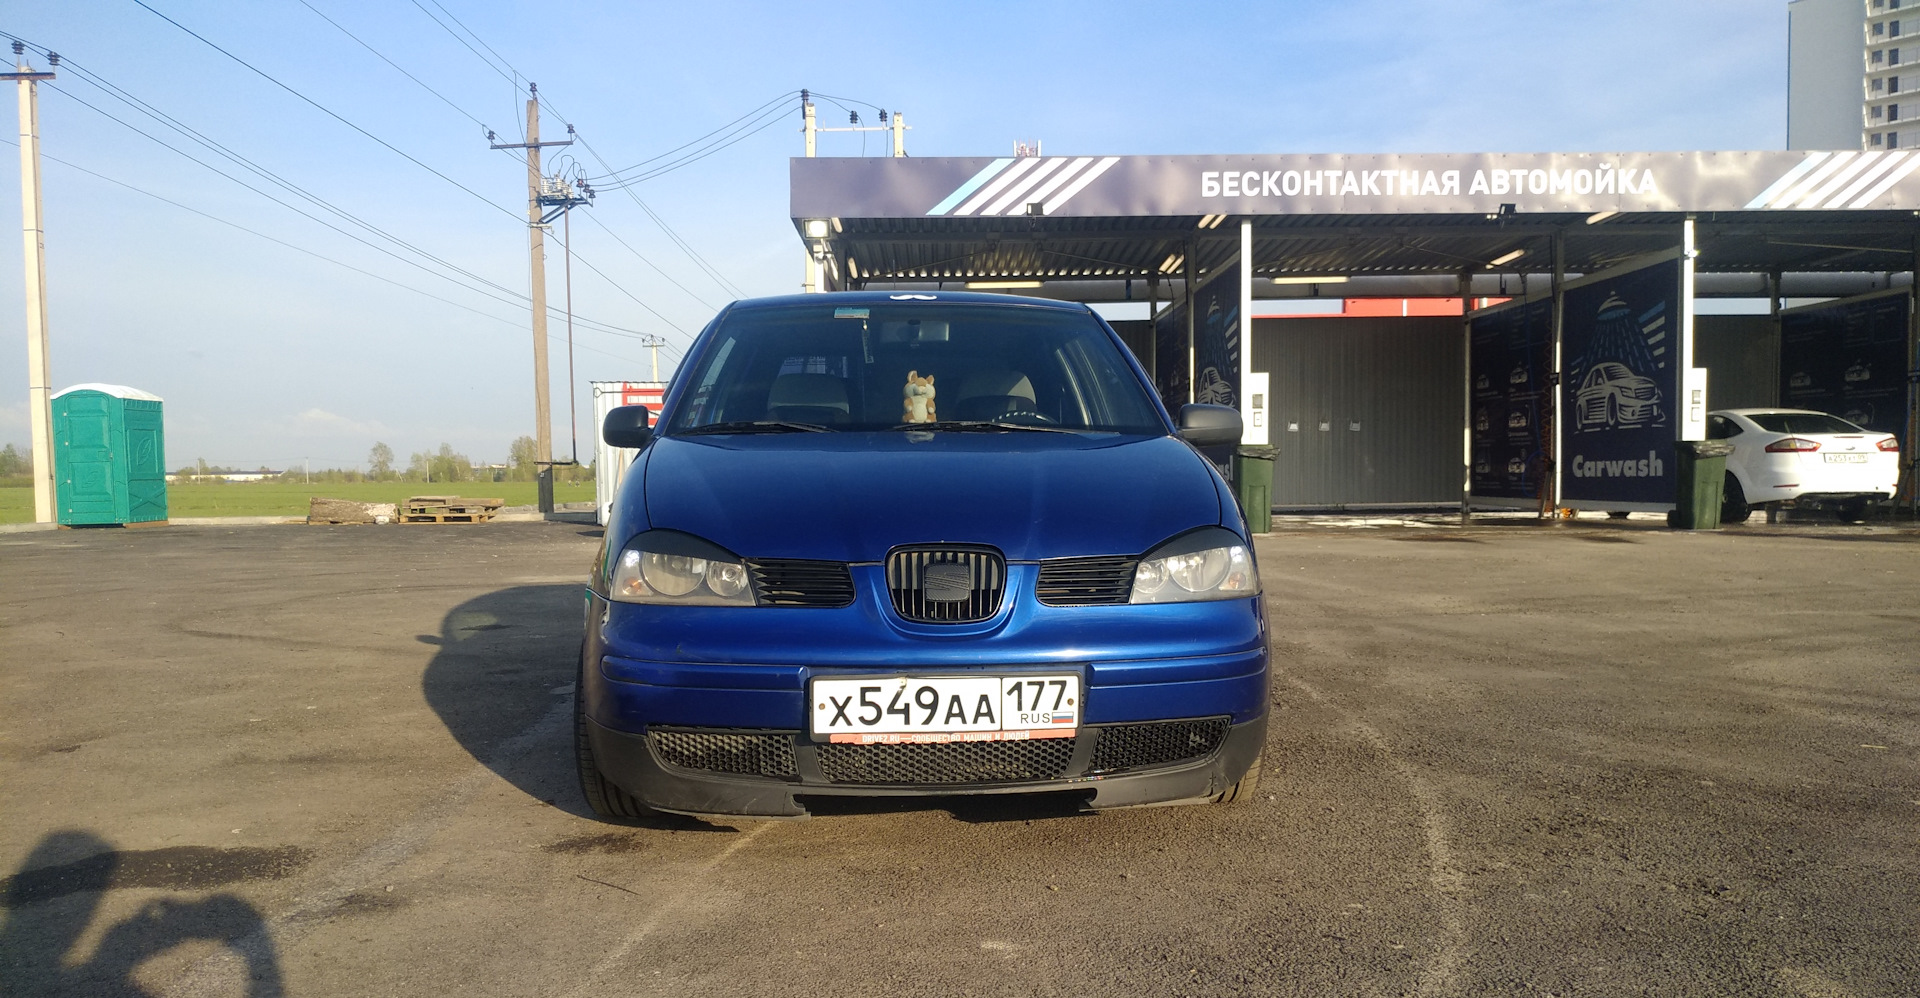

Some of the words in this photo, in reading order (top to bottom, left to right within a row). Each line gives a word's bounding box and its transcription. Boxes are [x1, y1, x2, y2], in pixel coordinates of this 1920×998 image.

[1201, 170, 1461, 197] БЕСКОНТАКТНАЯ
[1469, 163, 1654, 196] АВТОМОЙКА
[1572, 450, 1663, 477] Carwash
[1006, 680, 1067, 711] 177
[1020, 713, 1051, 724] RUS
